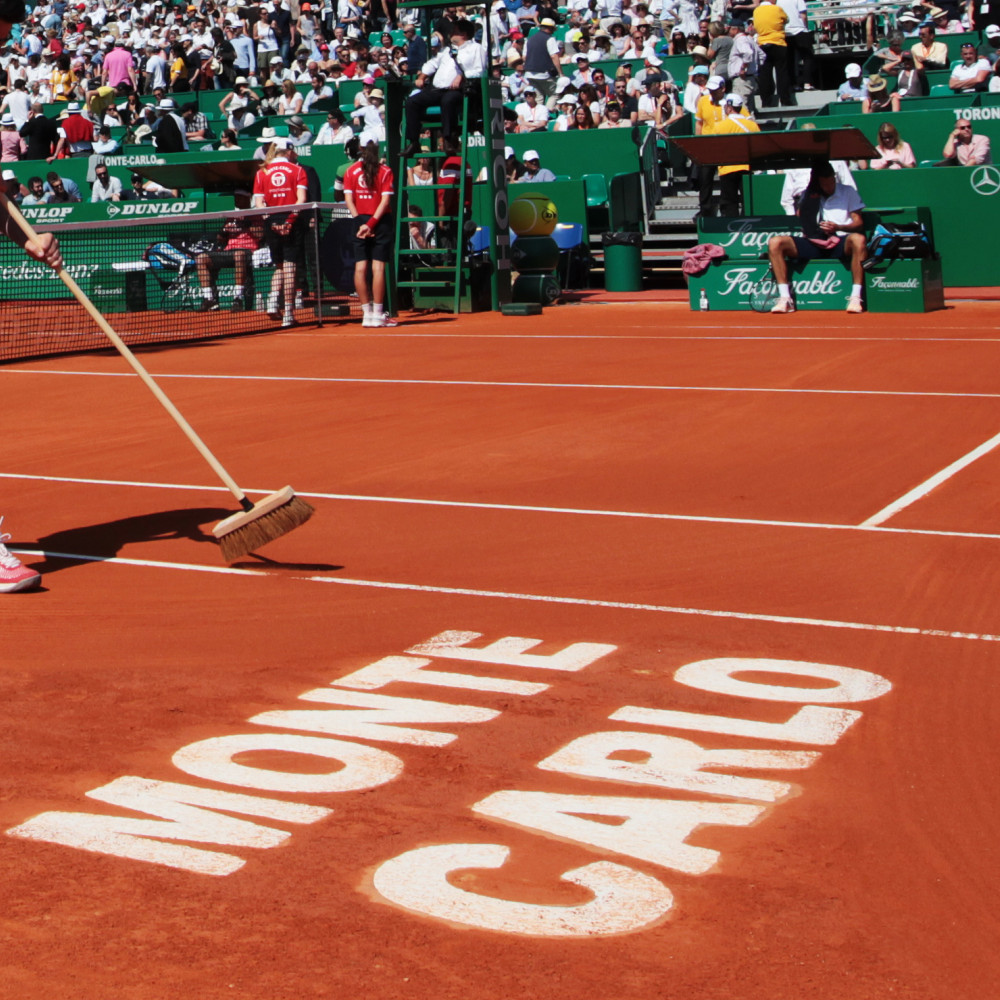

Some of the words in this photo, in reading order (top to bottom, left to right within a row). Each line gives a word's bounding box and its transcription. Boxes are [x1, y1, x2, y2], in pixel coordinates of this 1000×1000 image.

[104, 155, 157, 167] ONTE-CARLO
[293, 145, 312, 157] OME
[489, 98, 511, 270] RICOH
[120, 196, 199, 215] DUNLOP
[3, 630, 618, 877] MONTE
[371, 656, 895, 939] CARLO
